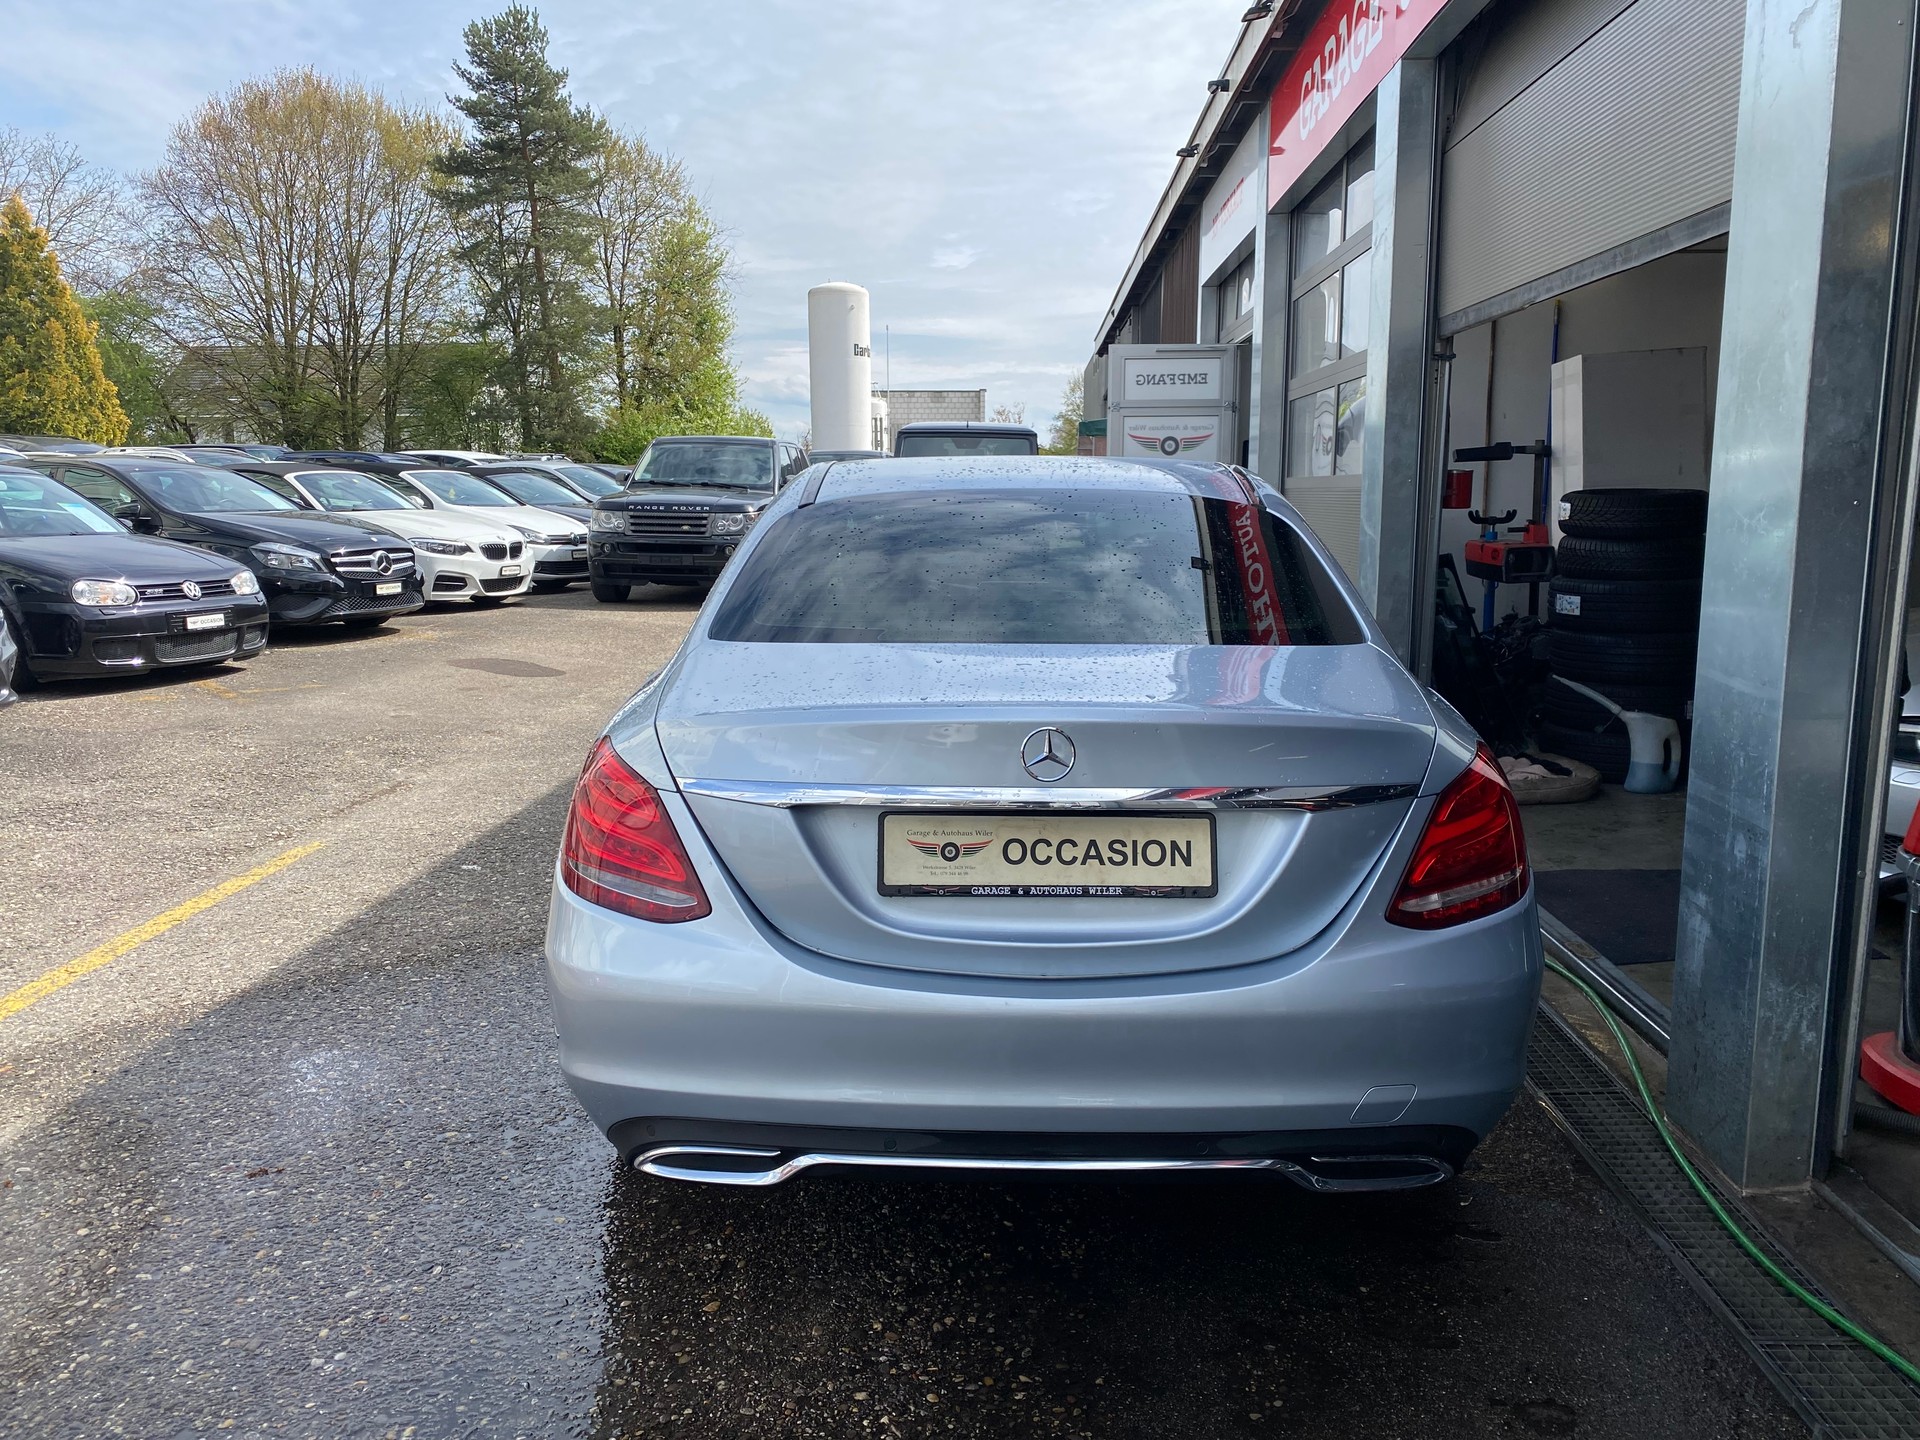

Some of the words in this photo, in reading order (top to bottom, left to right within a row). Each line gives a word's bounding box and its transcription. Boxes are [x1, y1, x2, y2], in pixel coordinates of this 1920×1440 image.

[1300, 0, 1383, 141] GARAGE
[906, 829, 931, 838] Garage
[932, 829, 939, 837] &
[940, 829, 973, 837] Autohaus
[975, 829, 993, 837] Wiler
[1002, 838, 1192, 867] OCCASION
[971, 887, 1011, 895] GARAGE
[1018, 887, 1024, 895] &
[1030, 887, 1083, 895] AUTOHAUS
[1089, 887, 1123, 895] WILER
